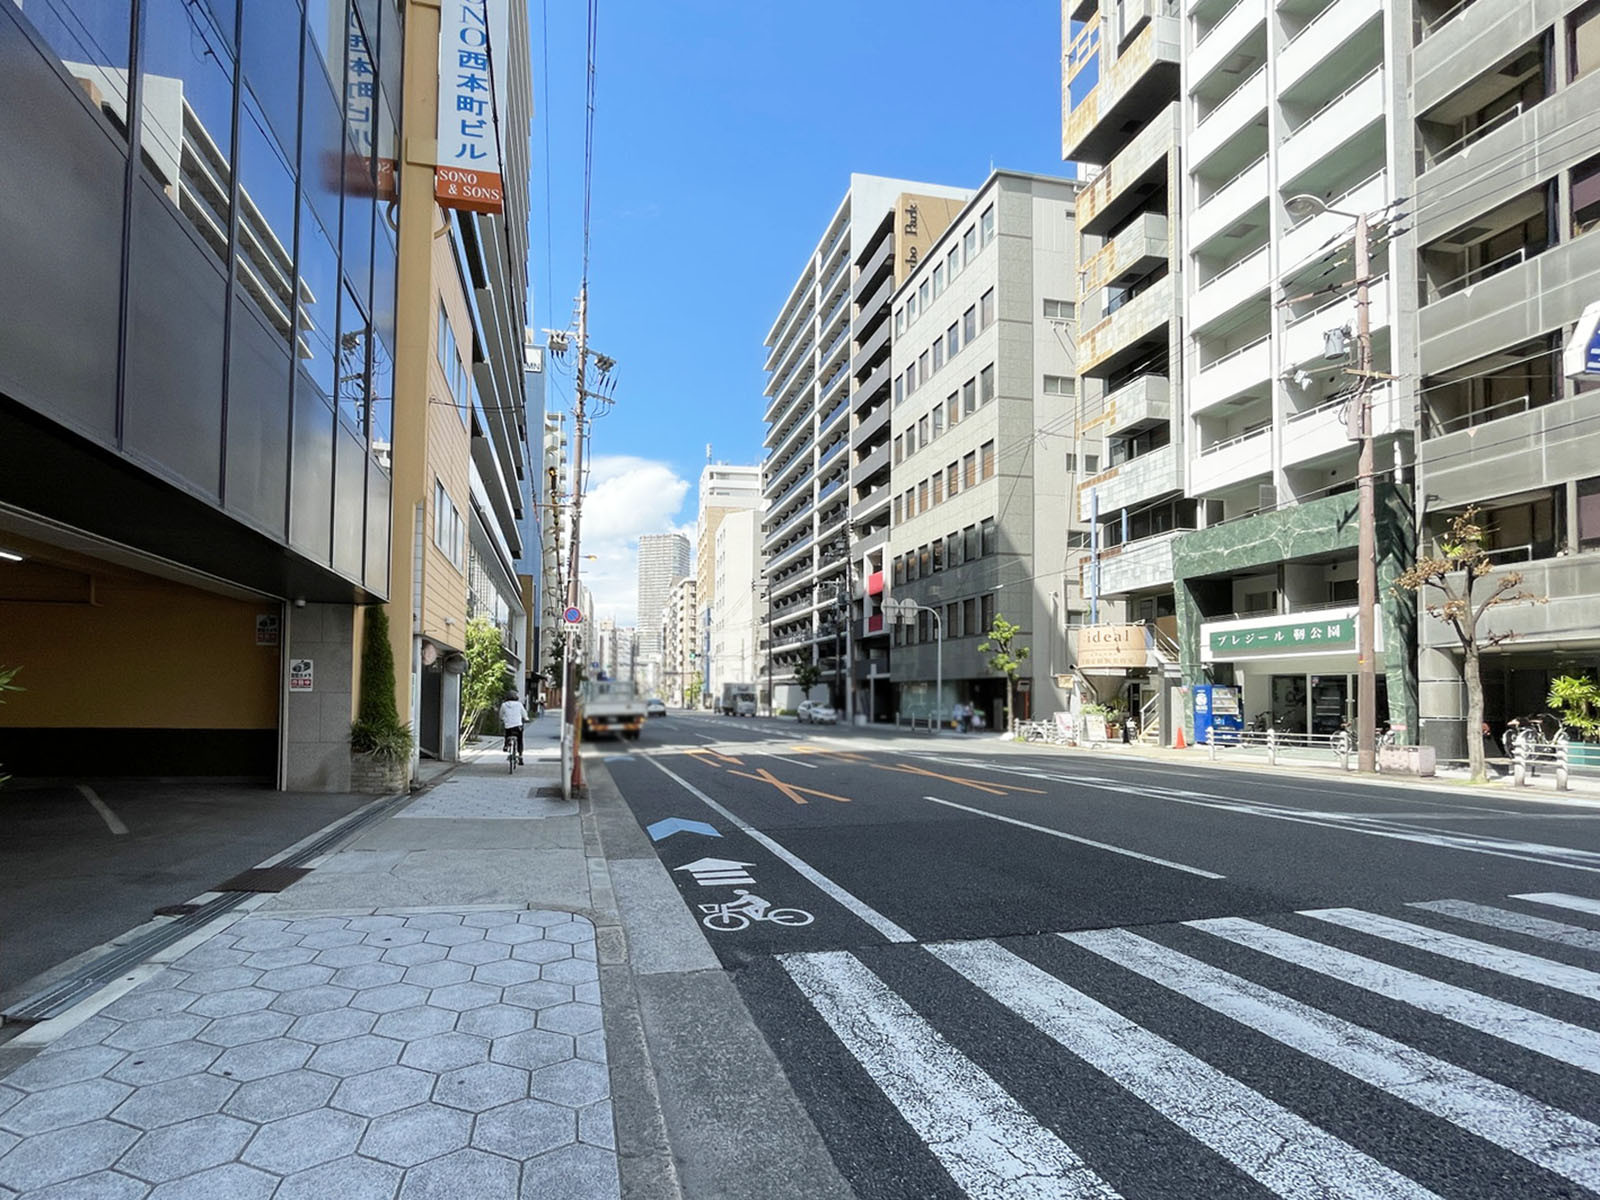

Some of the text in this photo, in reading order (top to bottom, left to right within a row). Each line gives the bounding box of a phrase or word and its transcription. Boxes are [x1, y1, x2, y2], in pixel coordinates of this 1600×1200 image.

[455, 0, 489, 160] NO西本町ビル
[439, 169, 477, 184] SONO
[448, 184, 500, 200] & SONS
[904, 204, 918, 236] Park
[1087, 629, 1129, 643] ideal
